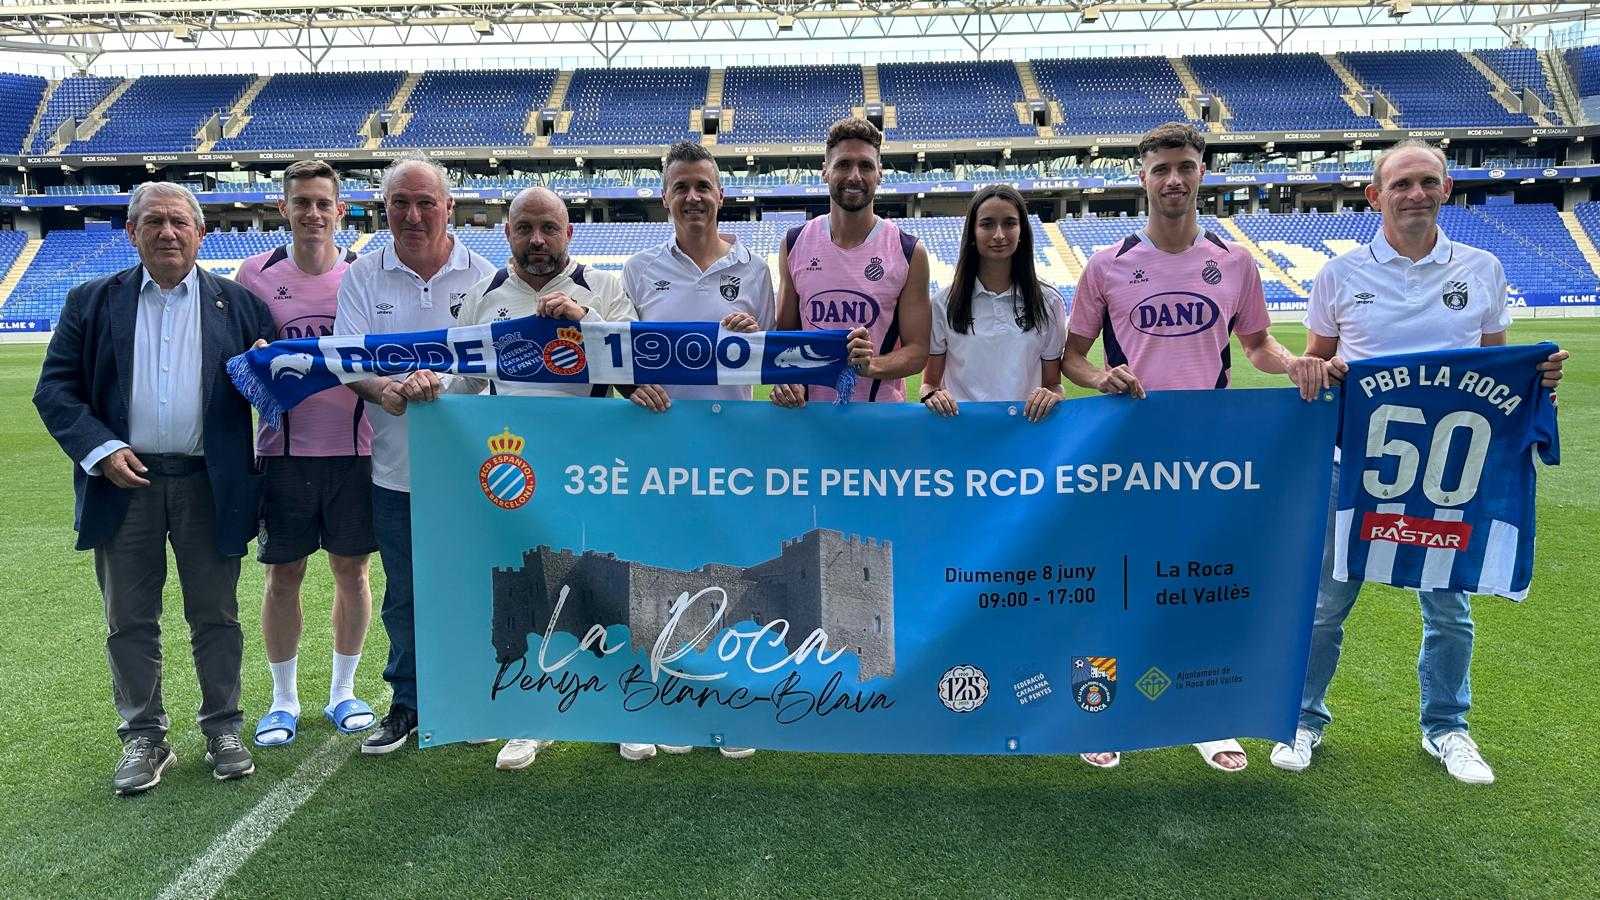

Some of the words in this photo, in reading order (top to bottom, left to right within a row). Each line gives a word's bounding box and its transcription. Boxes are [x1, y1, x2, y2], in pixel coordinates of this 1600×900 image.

[1032, 181, 1070, 189] KELME
[810, 300, 867, 324] DANI
[1138, 302, 1204, 328] DANI
[336, 340, 486, 376] RCDE
[604, 332, 750, 370] 1900
[1360, 366, 1411, 398] PBB
[1420, 365, 1450, 387] LA
[1458, 370, 1522, 416] ROCA
[1362, 404, 1492, 506] 50
[480, 462, 492, 477] RCD
[493, 455, 534, 480] ESPANYOL
[564, 457, 629, 495] 33È
[640, 467, 754, 496] APLEC
[766, 468, 809, 496] DE
[821, 469, 954, 497] PENYES
[966, 468, 1045, 497] RCD
[1056, 461, 1260, 494] ESPANYOL
[489, 485, 534, 508] BARCELONA
[1370, 526, 1461, 548] RASTAR
[945, 566, 1036, 585] Diumenge
[1043, 566, 1053, 580] 8
[1056, 564, 1096, 583] juny
[1156, 561, 1180, 577] La
[1188, 561, 1233, 577] Roca
[979, 592, 1028, 609] 09:00
[1048, 588, 1096, 604] 17:00
[1156, 588, 1187, 606] del
[1193, 584, 1250, 604] Vallès
[538, 584, 623, 673] La
[650, 587, 853, 682] Roca
[491, 655, 608, 714] Penya
[619, 664, 896, 726] Blanc-Blava
[947, 676, 980, 701] 125
[1016, 680, 1049, 697] CATALANA
[1028, 687, 1052, 701] PENYES
[1081, 702, 1089, 711] LA
[1089, 703, 1108, 712] ROCA
